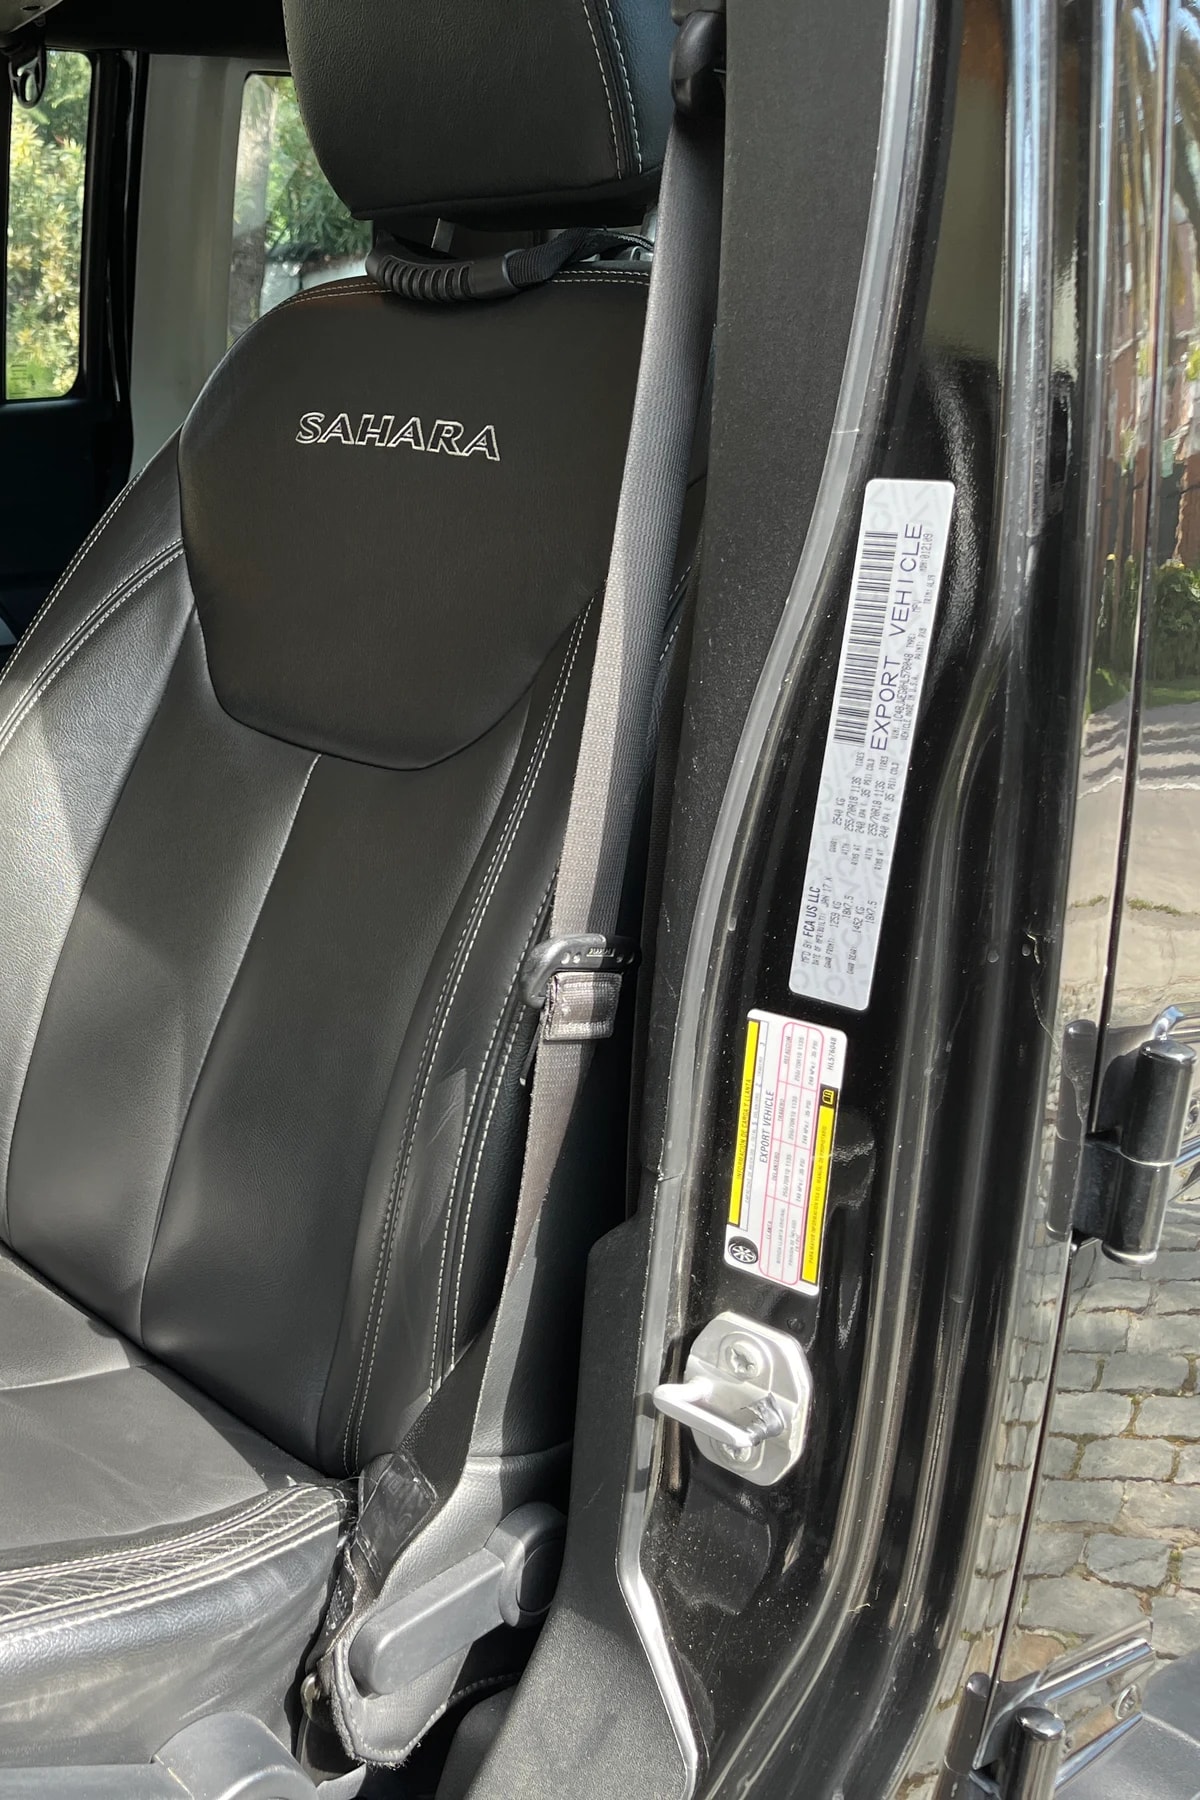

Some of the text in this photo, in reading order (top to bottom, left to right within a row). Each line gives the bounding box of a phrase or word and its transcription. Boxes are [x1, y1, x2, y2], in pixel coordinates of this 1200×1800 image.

[295, 412, 501, 462] SAHARA
[869, 522, 923, 751] EXPORT VEHICLE
[805, 904, 817, 918] US
[807, 885, 820, 903] LLC
[802, 918, 815, 938] FCA
[759, 1089, 774, 1163] EXPORT VEHICLE
